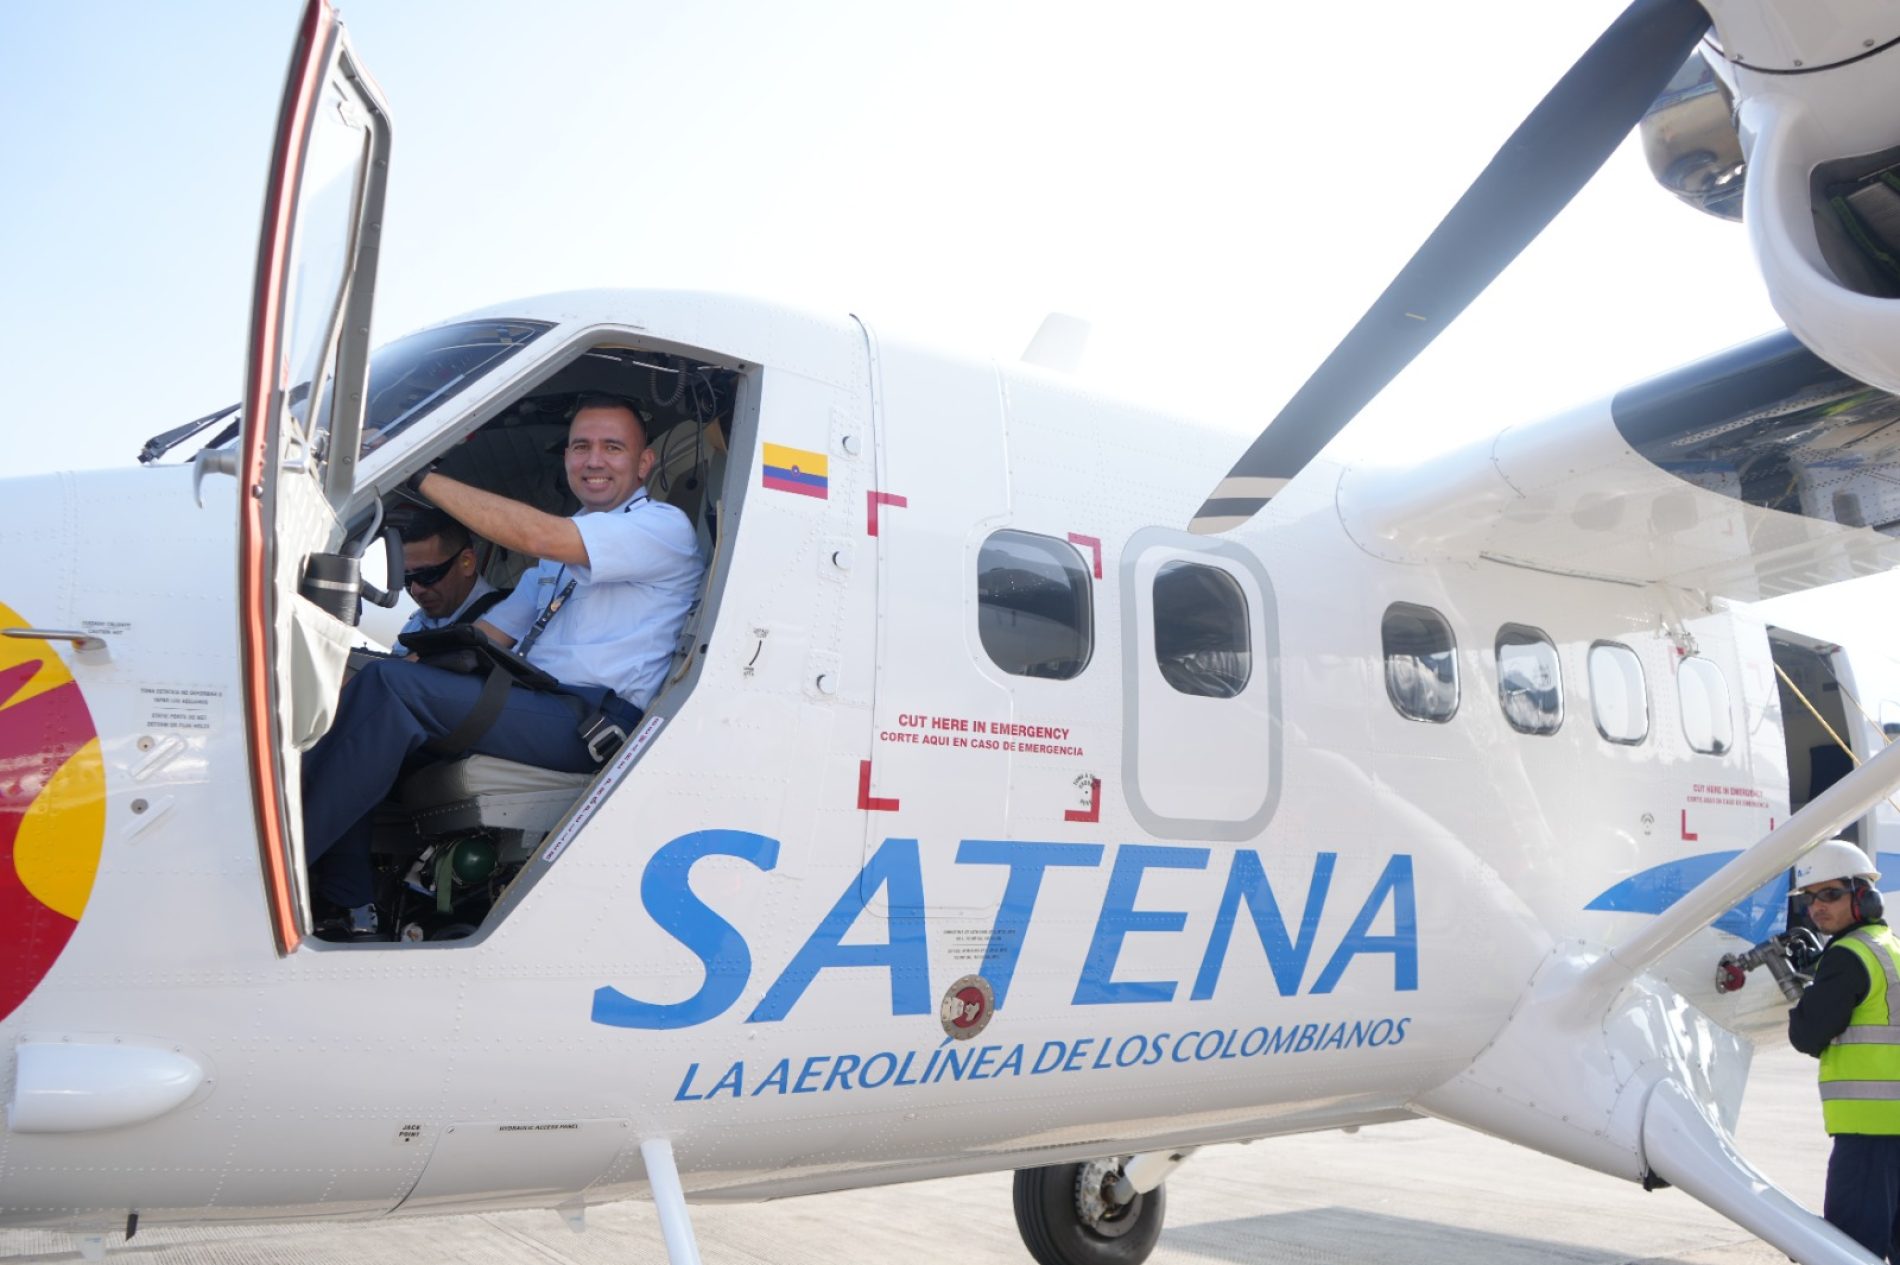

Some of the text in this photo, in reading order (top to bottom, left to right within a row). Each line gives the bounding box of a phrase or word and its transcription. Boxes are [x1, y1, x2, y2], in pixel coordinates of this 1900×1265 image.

[880, 730, 1084, 757] CORTE AQUI EN CASO DE EMERGENCIA
[898, 713, 1070, 741] CUT HERE IN EMERGENCY
[591, 829, 1419, 1030] SATENA
[674, 1017, 1412, 1102] LA AEROLÍNEA DE LOS COLOMBIANOS
